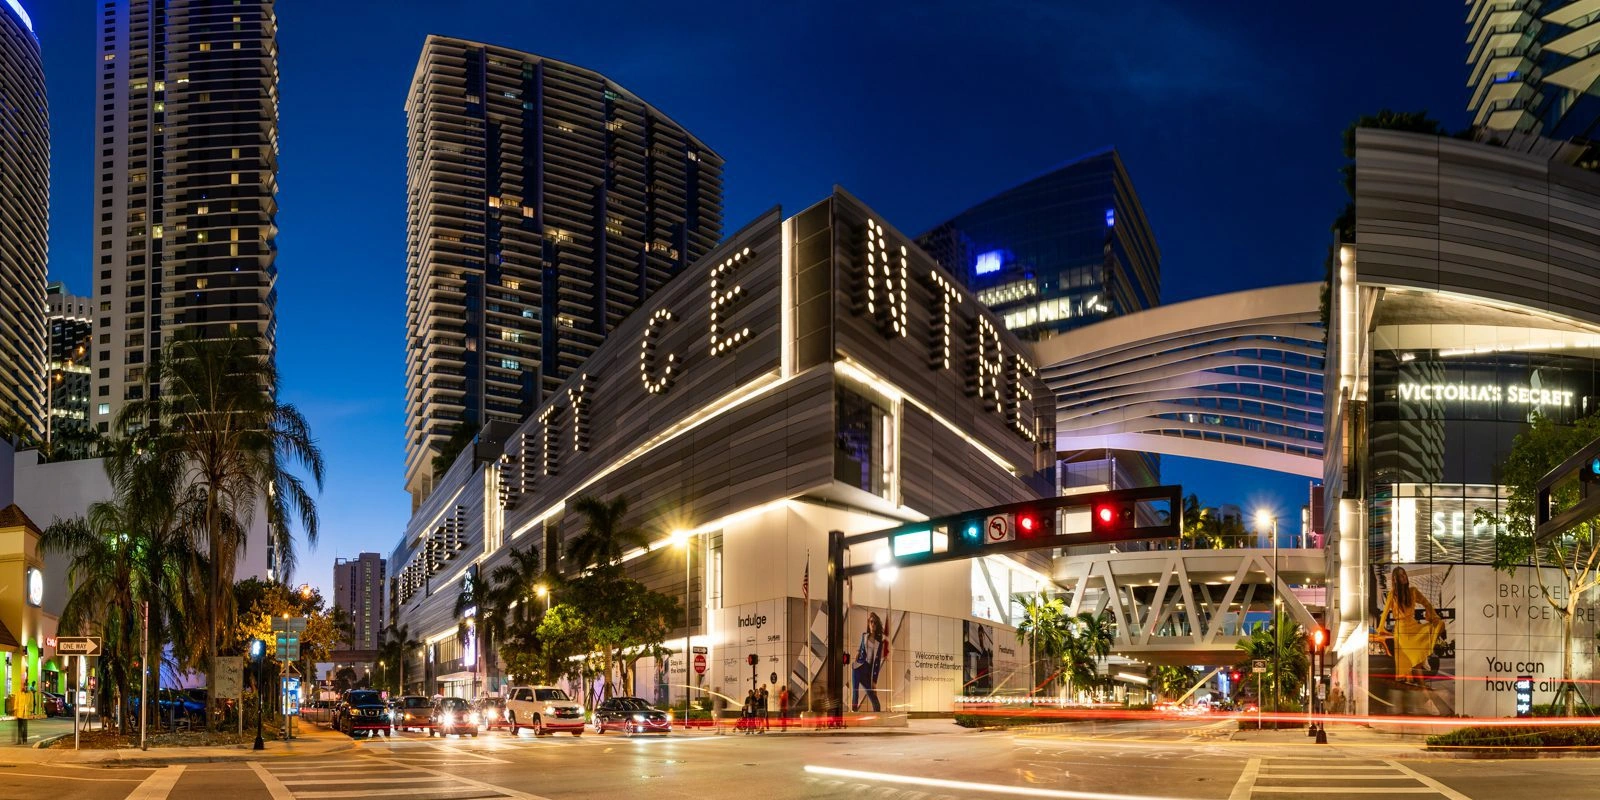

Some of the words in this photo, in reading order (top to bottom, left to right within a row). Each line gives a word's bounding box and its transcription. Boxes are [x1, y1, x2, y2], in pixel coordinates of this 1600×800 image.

[1400, 383, 1502, 401] VICTORIA'S
[1507, 385, 1573, 406] SECRET
[1499, 583, 1579, 601] BRICKEL
[1482, 603, 1521, 619] CITY
[1528, 605, 1595, 622] CENRE
[738, 613, 767, 629] Indulge
[914, 651, 939, 660] Welcome
[914, 660, 933, 669] Centre
[933, 661, 940, 669] of
[1486, 657, 1512, 672] You
[1516, 662, 1545, 673] can
